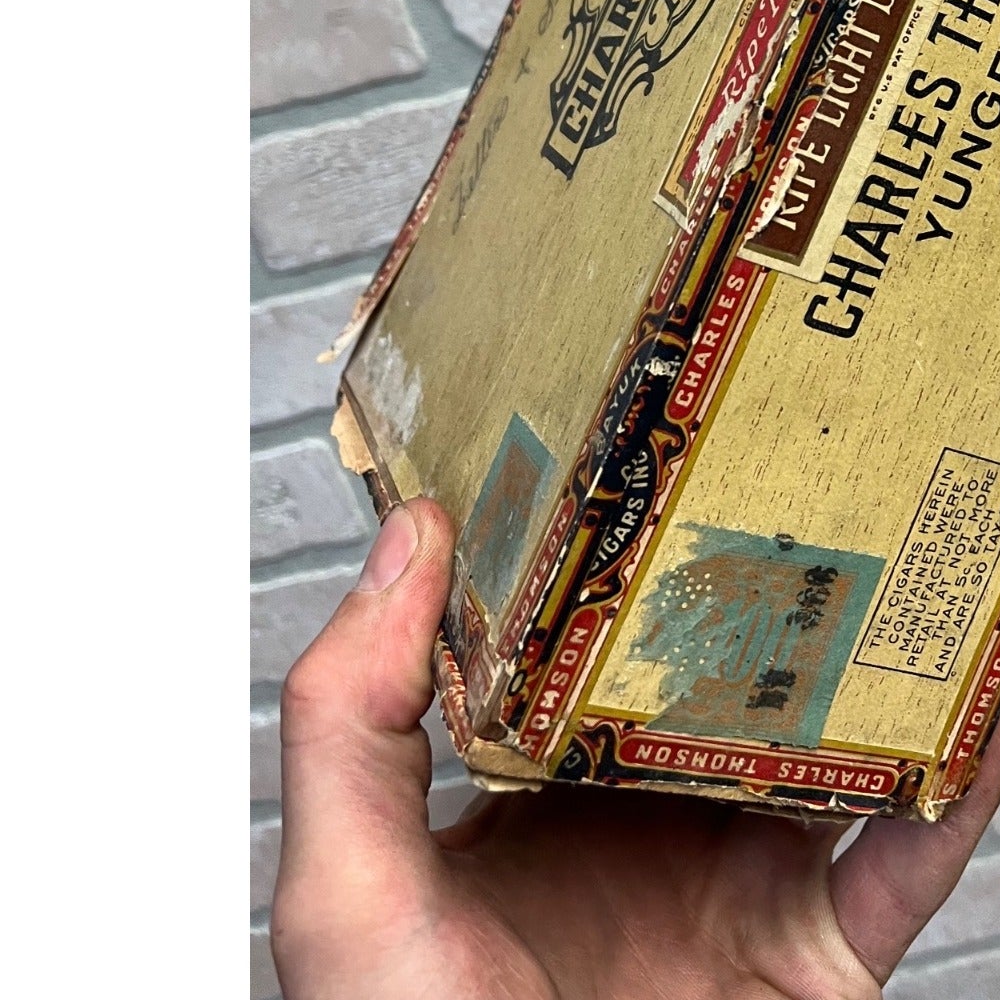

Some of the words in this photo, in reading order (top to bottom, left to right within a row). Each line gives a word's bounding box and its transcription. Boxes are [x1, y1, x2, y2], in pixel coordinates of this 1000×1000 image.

[720, 16, 770, 101] Ripe
[813, 13, 881, 127] LIGHT
[891, 45, 905, 68] PAT
[901, 3, 924, 44] OFFICE
[659, 163, 723, 294] CHARLES
[802, 64, 964, 339] CHARLES
[674, 273, 746, 408] CHARLES
[868, 607, 895, 650] THE
[886, 539, 924, 607] CIGARS
[918, 466, 956, 534] HEREIN
[886, 539, 939, 644] CONTAINED
[933, 478, 966, 533] WERE
[898, 504, 971, 652] MANUFACTURED
[962, 477, 981, 499] TO
[906, 603, 941, 667] RETAIL
[934, 574, 953, 600] AT
[947, 531, 971, 570] NOT
[966, 467, 999, 523] MORE
[930, 592, 960, 642] THAN
[966, 506, 997, 555] EACH
[932, 630, 958, 673] AND
[951, 589, 977, 629] ARE
[969, 559, 989, 586] SO
[518, 624, 584, 754] HOMSON
[636, 744, 757, 772] THOMSON
[777, 760, 886, 789] CHARLES
